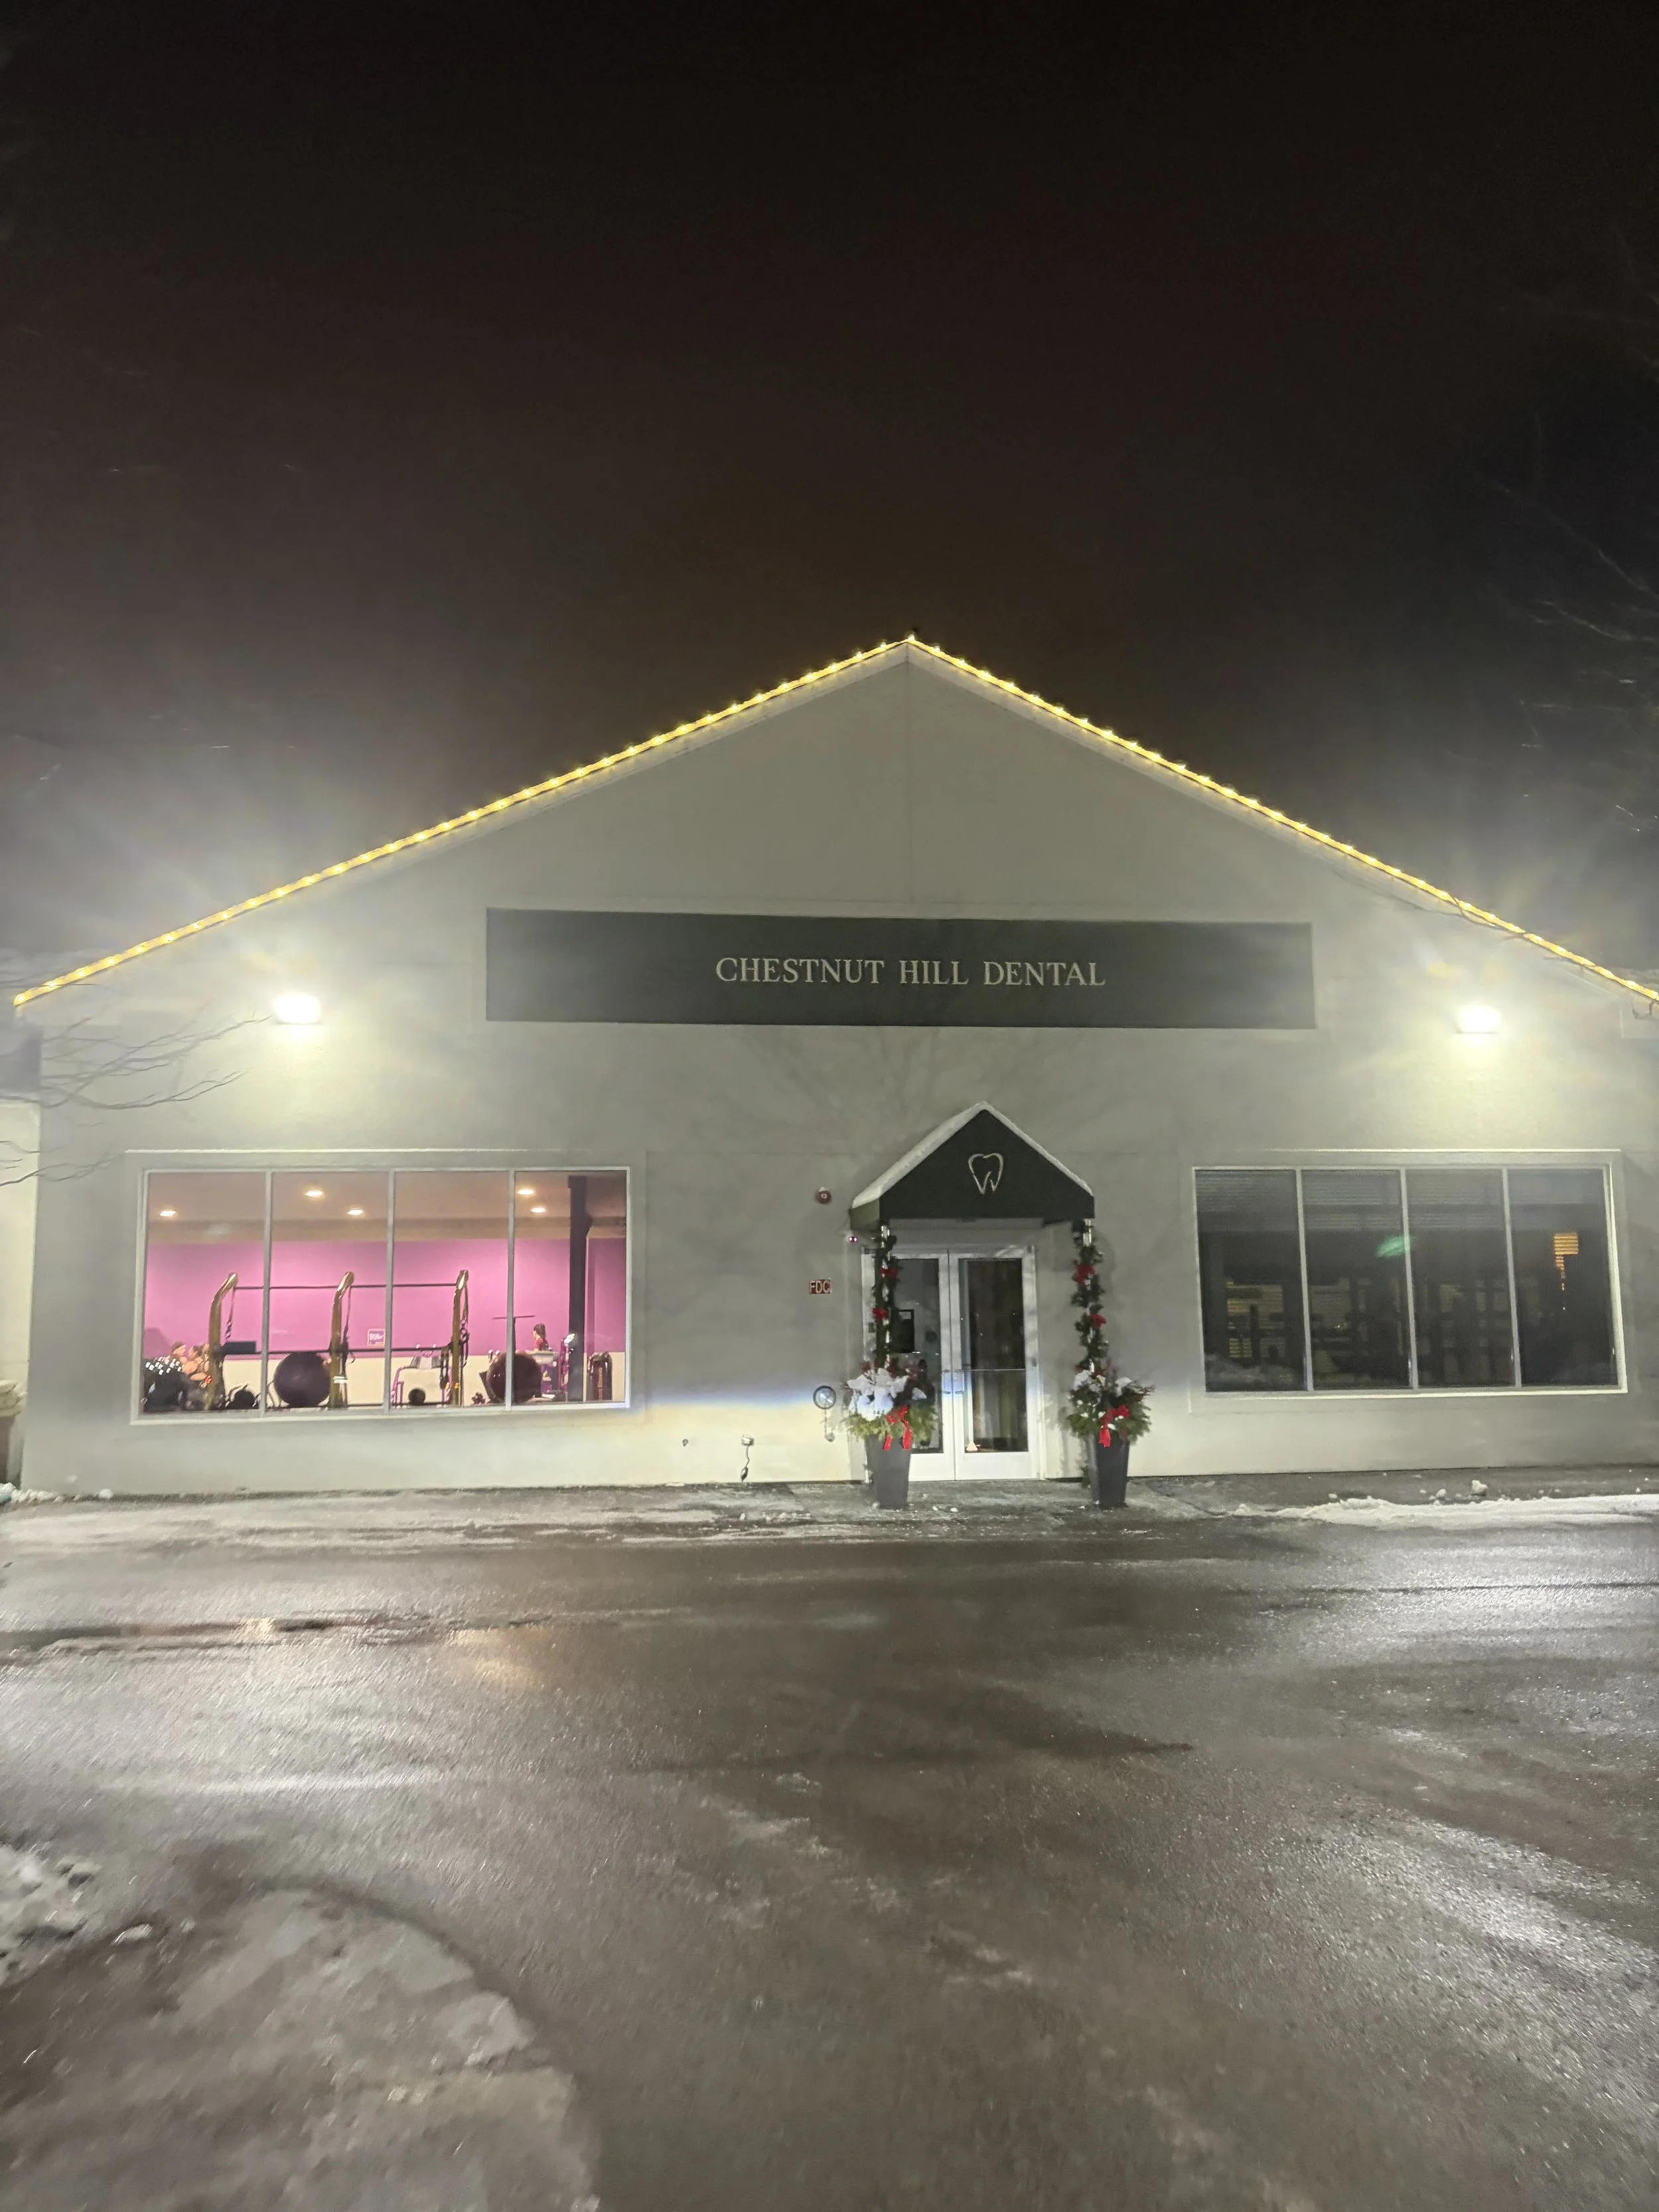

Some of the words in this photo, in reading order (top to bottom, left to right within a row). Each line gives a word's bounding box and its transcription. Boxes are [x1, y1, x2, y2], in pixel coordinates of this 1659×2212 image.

[715, 957, 885, 984] CHESTNUT
[899, 960, 969, 986] HILL
[983, 961, 1106, 987] DENTAL
[810, 1280, 830, 1293] FDC
